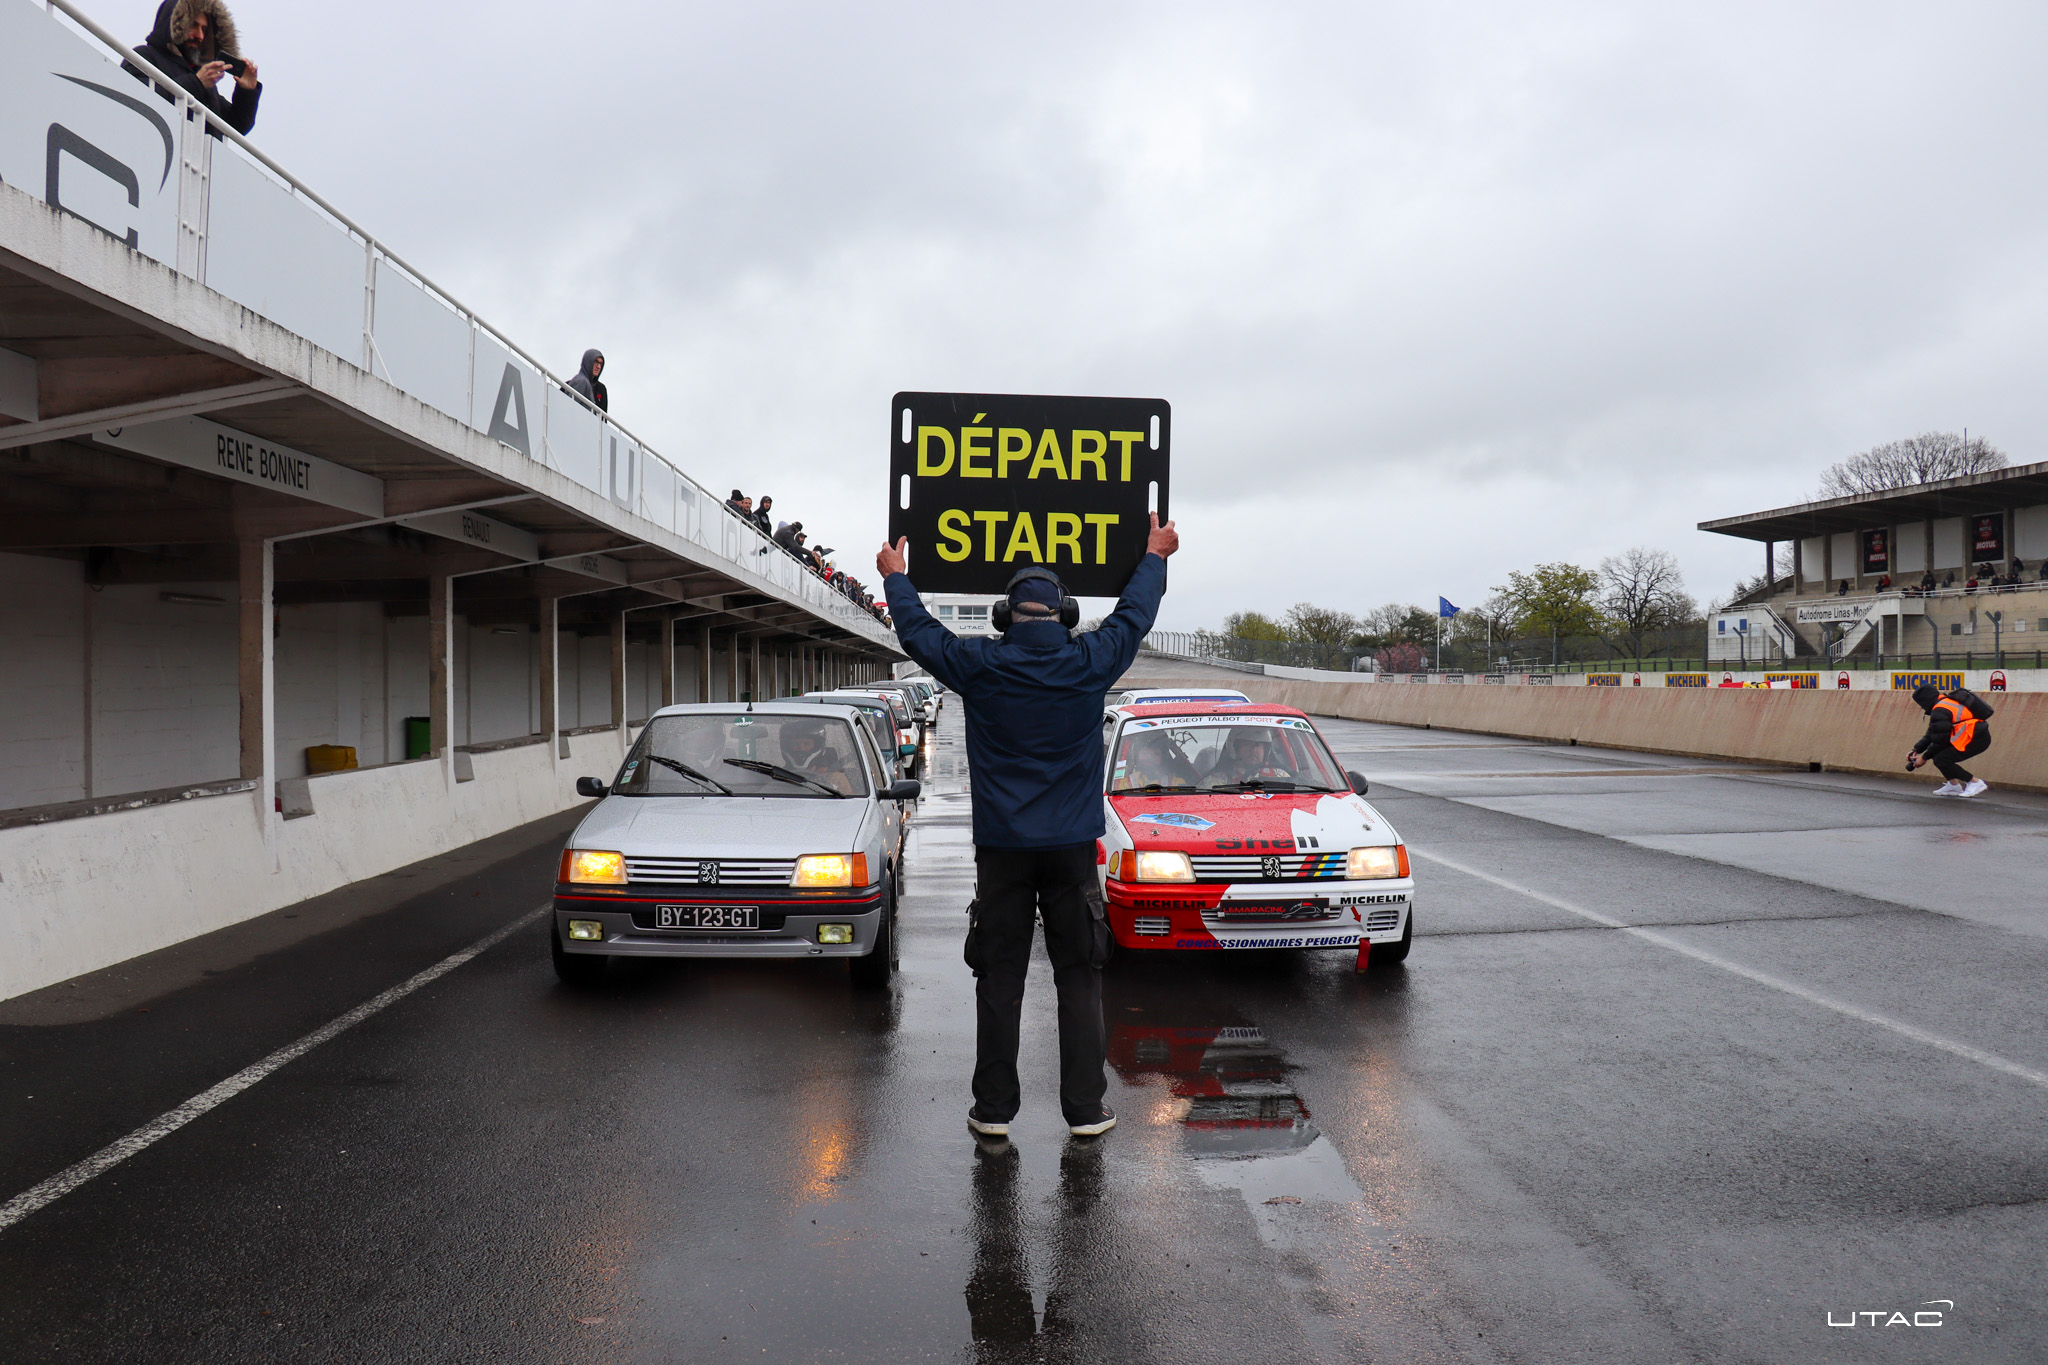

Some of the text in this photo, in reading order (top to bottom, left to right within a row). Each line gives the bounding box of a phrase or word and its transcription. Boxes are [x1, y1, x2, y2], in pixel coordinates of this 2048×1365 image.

[917, 413, 1145, 482] DÉPART
[217, 434, 310, 490] RENE BONNET
[462, 515, 490, 543] RENAULT
[935, 508, 1120, 565] START
[1975, 541, 1997, 549] MOTUL
[1798, 608, 1832, 620] Autodrome
[1589, 675, 1620, 686] MICHELIN
[1667, 675, 1707, 687] MICHELIN
[1894, 674, 1961, 690] MICHELIN
[1161, 717, 1203, 725] PEUGEOT
[1215, 836, 1319, 850] Shell
[1133, 899, 1206, 908] MICHELIN
[1340, 894, 1406, 905] MICHELIN
[661, 907, 753, 927] BY-123-GT
[1176, 934, 1360, 949] CONCESSIONNAIRES PEUGEOT
